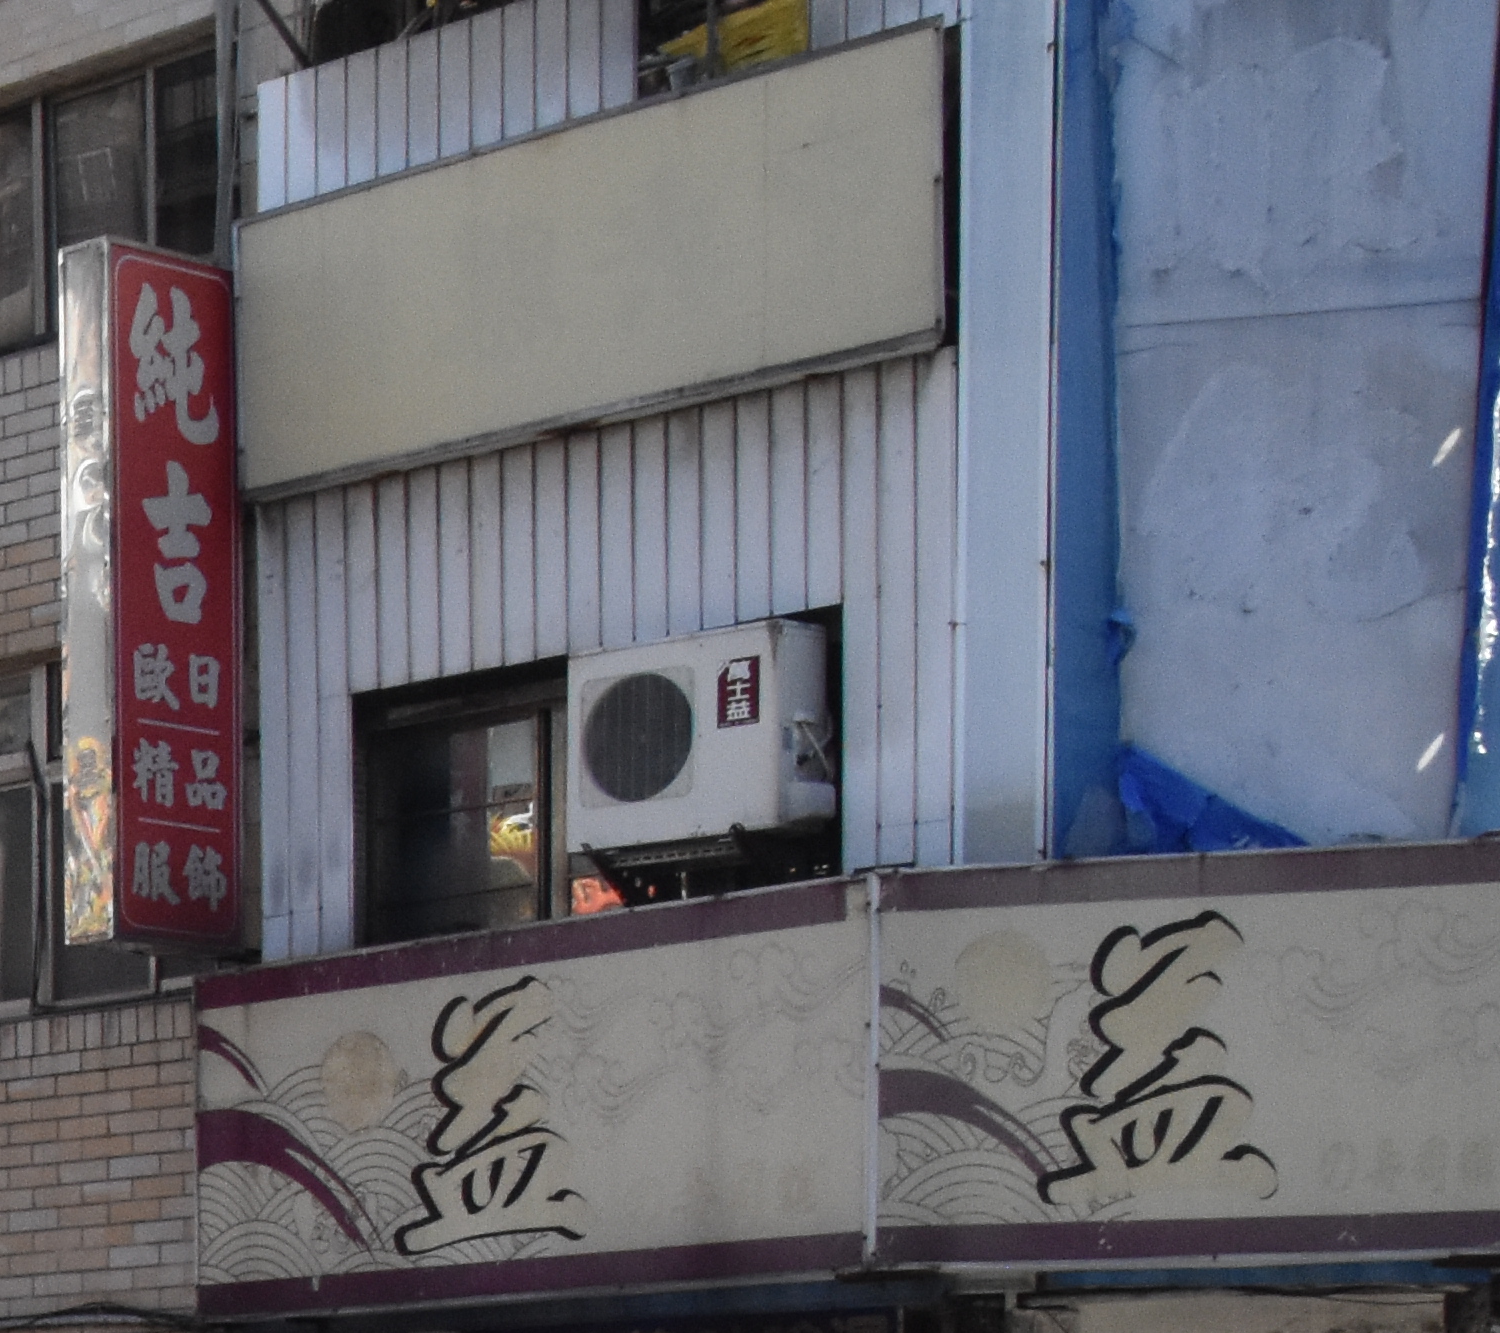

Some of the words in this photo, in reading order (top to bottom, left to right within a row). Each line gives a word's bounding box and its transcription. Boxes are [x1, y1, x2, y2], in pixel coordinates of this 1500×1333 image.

[129, 281, 220, 625] 純吉
[133, 643, 221, 710] 歐日
[132, 738, 228, 810] 精品
[132, 841, 228, 911] 服飾
